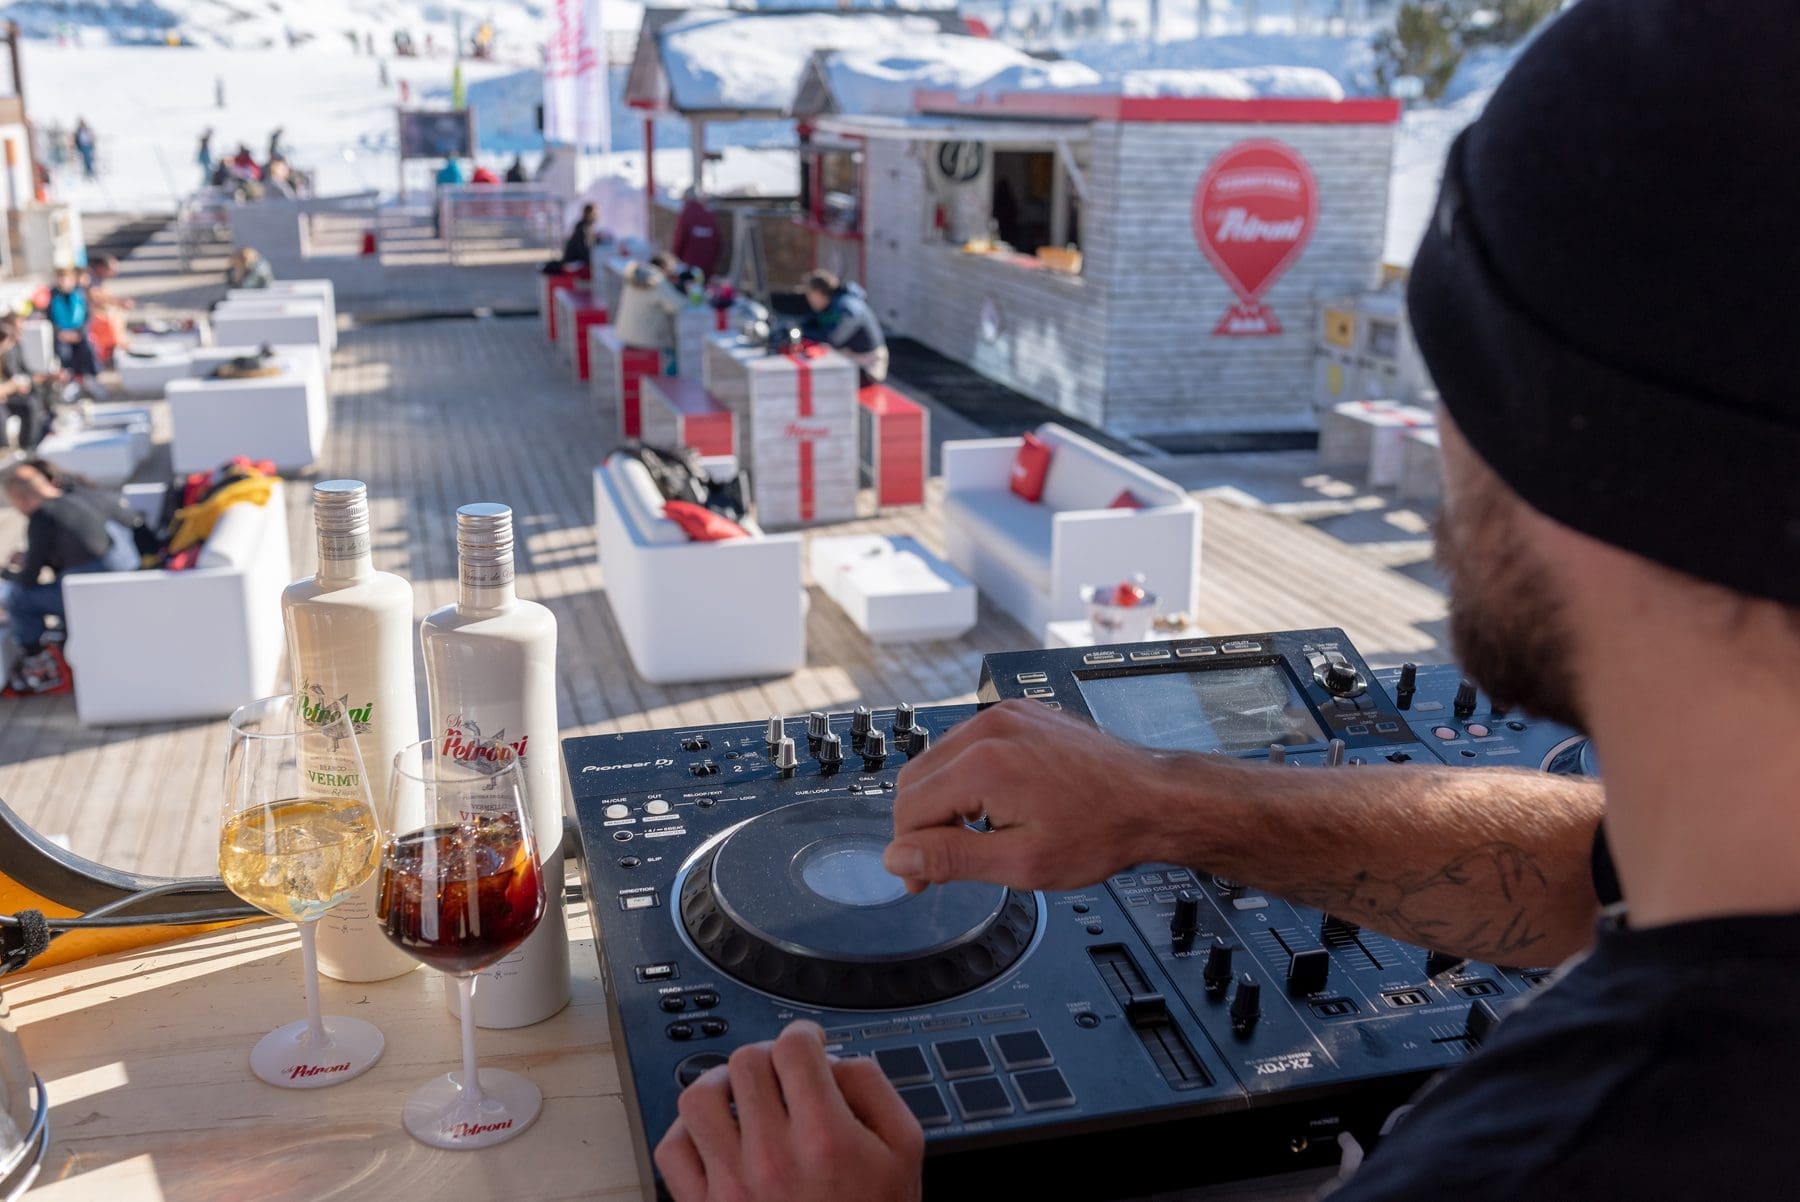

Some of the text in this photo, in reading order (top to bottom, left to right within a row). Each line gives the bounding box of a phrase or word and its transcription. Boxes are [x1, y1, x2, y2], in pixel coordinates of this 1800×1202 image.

[442, 728, 528, 762] Petroni
[581, 762, 652, 773] Pioneer
[733, 765, 743, 773] 2
[795, 788, 830, 796] CUE/LOOP
[619, 886, 655, 895] DIRECTION
[1123, 887, 1152, 895] SOUND
[1152, 884, 1181, 892] COLOR
[1255, 913, 1268, 922] 3
[290, 1062, 351, 1080] Petroni
[1254, 1057, 1314, 1075] XDJ-XZ
